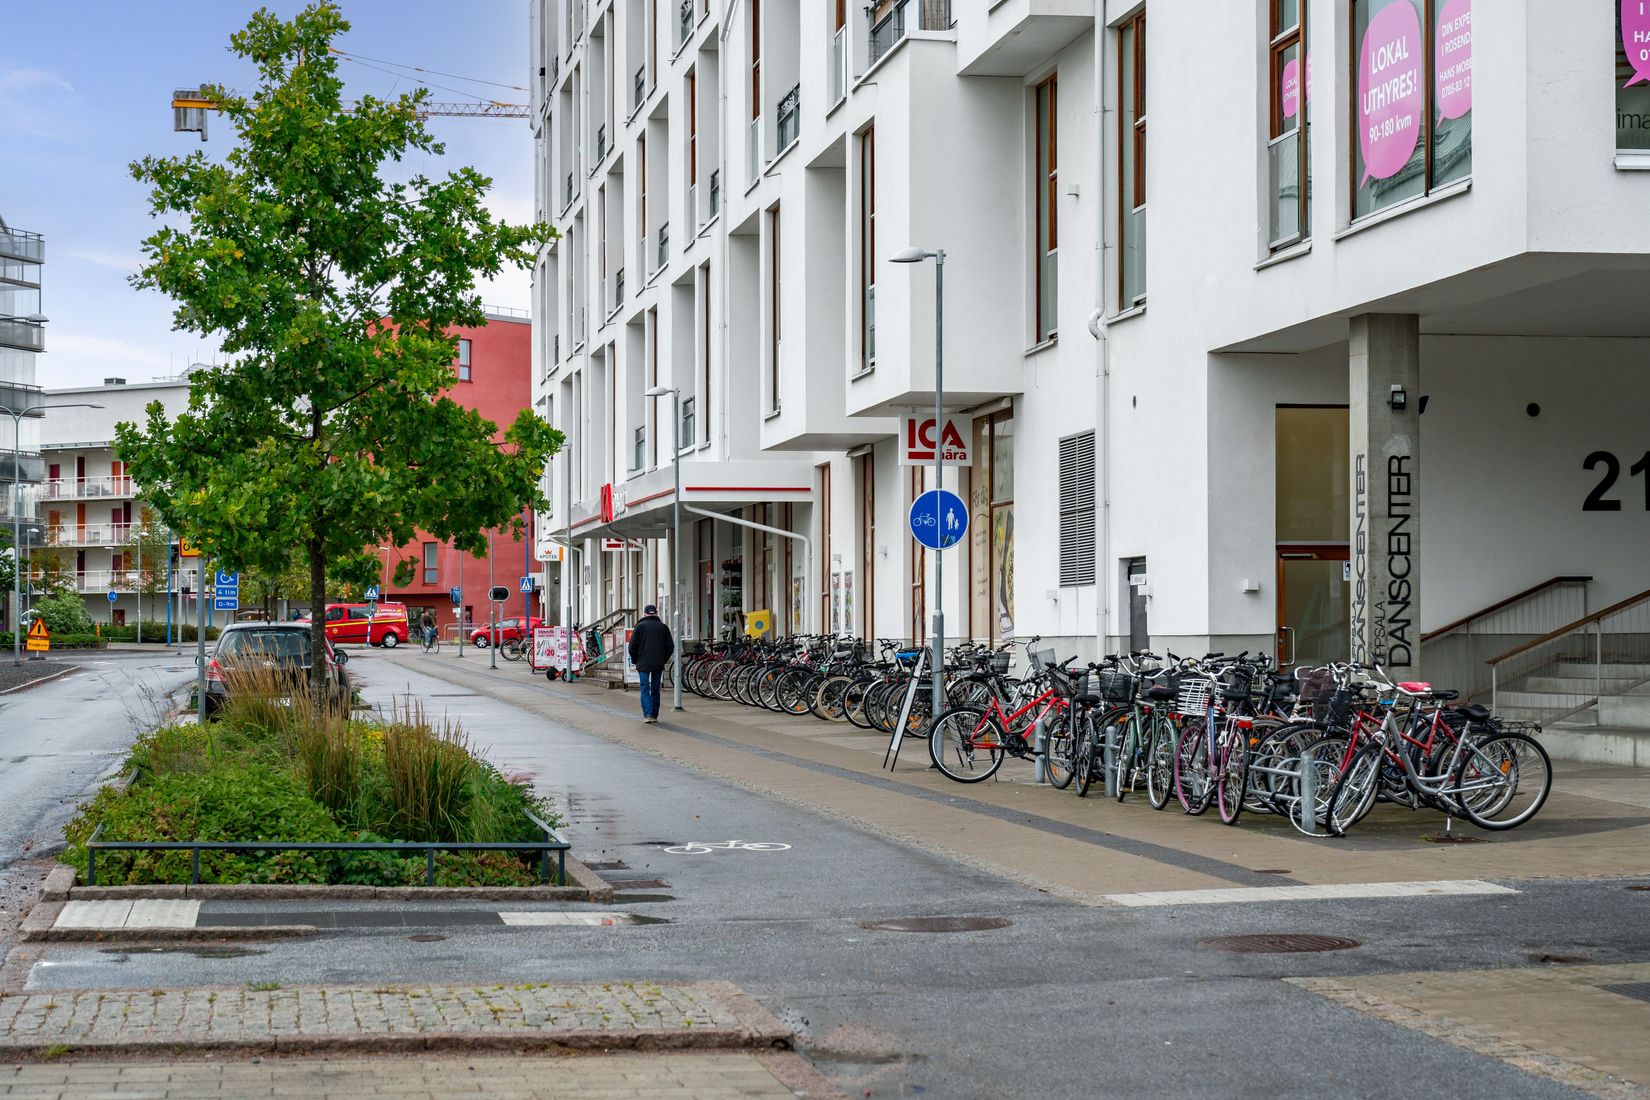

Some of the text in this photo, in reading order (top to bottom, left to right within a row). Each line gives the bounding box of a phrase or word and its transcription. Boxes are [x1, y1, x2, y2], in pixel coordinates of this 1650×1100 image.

[1441, 22, 1454, 37] DIN
[1445, 32, 1472, 54] ROSEND
[1372, 35, 1409, 74] LOKAL
[1639, 48, 1650, 61] 0
[1439, 65, 1455, 83] HANS
[1363, 68, 1417, 116] UTHYRES!
[1369, 114, 1412, 143] 90-180 kvm
[907, 418, 967, 449] ICA
[1582, 450, 1650, 511] 21
[1355, 453, 1366, 664] DANSCENTER
[1387, 455, 1412, 668] DANSCENTER
